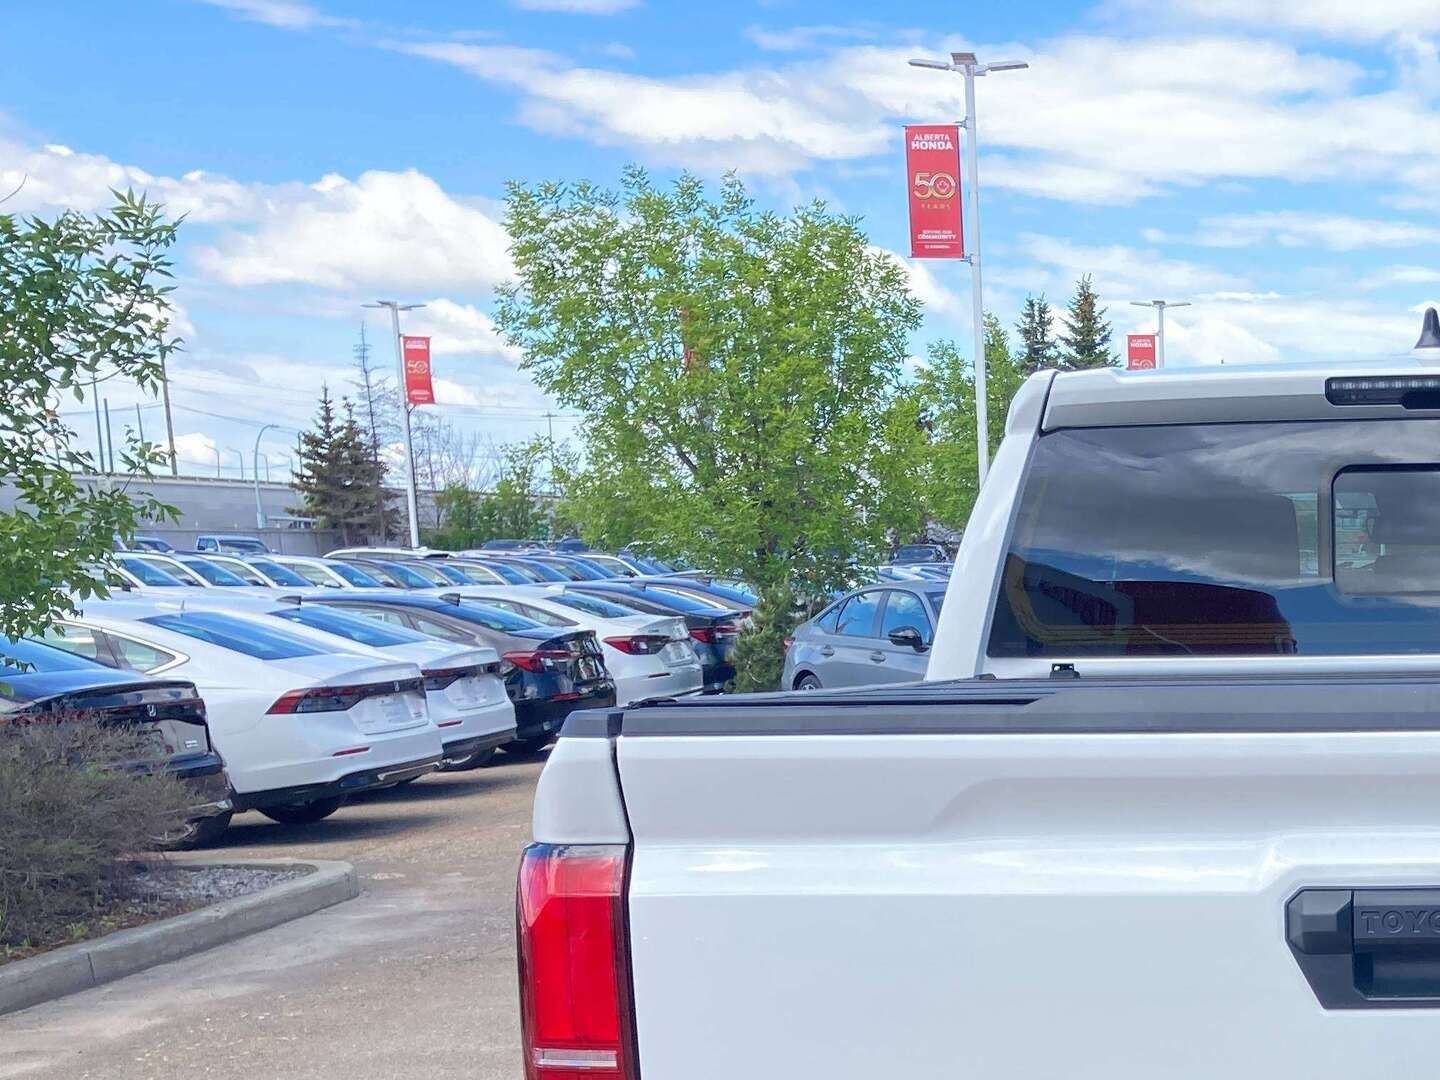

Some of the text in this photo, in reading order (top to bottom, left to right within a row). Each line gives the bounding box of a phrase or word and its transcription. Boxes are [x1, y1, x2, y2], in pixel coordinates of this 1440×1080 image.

[914, 133, 950, 141] ALBERTA
[911, 140, 954, 150] HONDA
[914, 172, 956, 200] 50
